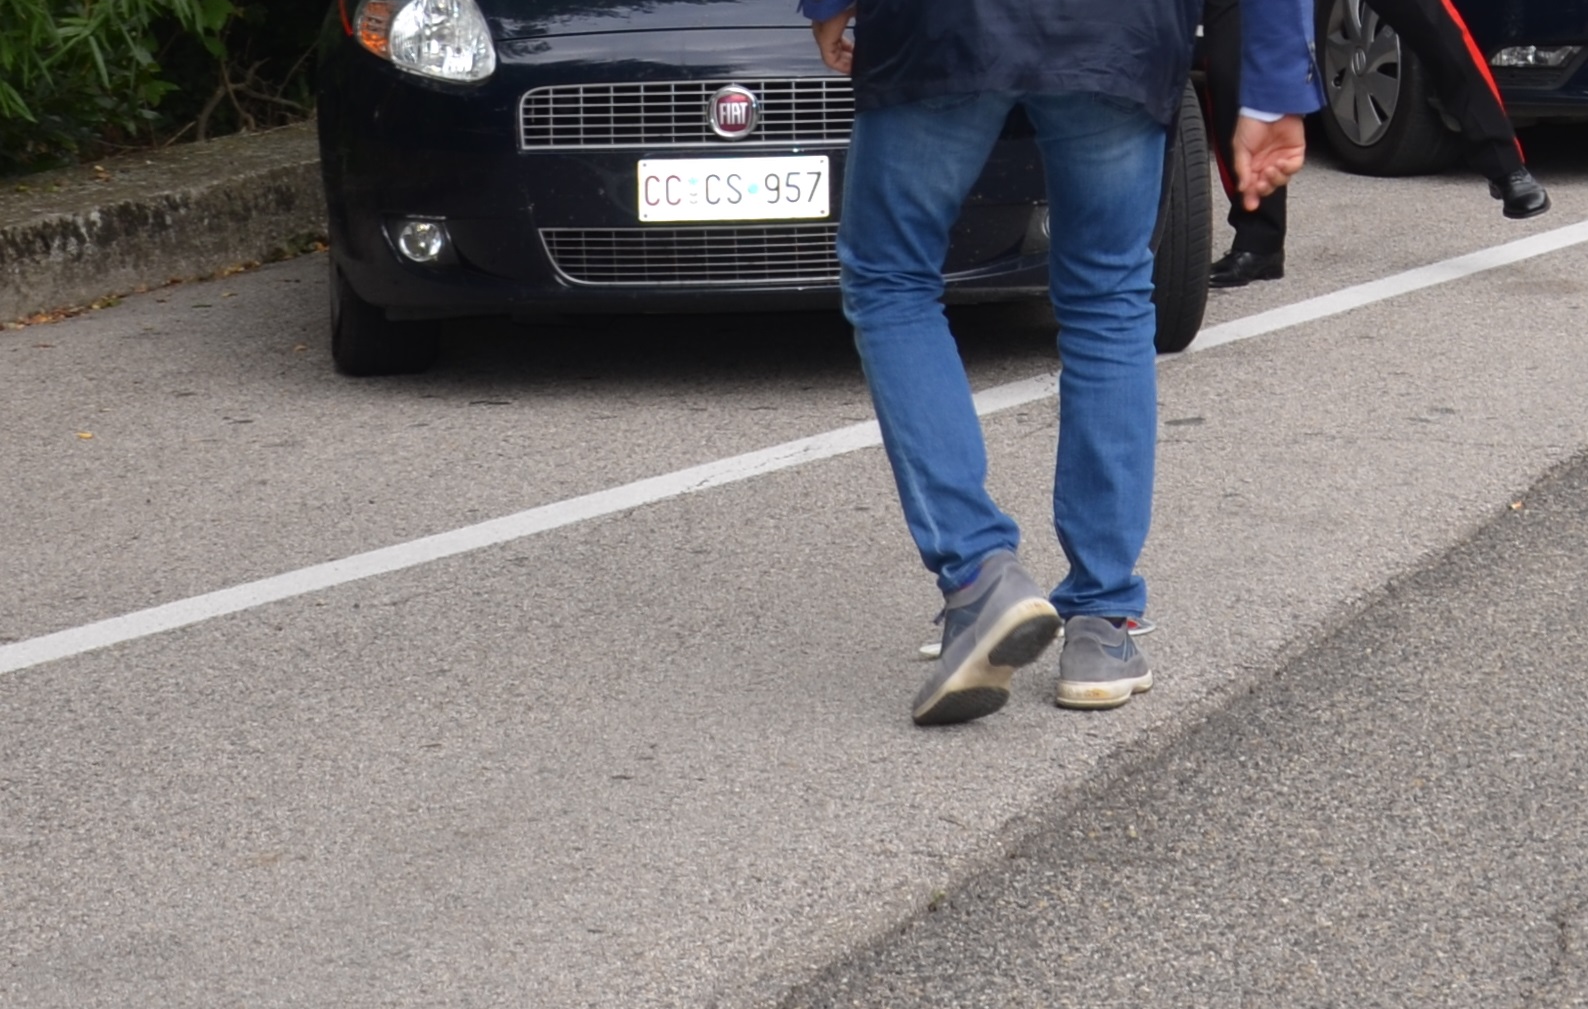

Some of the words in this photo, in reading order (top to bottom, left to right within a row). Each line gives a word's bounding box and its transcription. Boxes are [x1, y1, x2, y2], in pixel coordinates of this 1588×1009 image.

[719, 102, 748, 125] FIAT
[644, 175, 682, 206] CC
[705, 173, 742, 205] CS
[764, 171, 822, 204] 957
